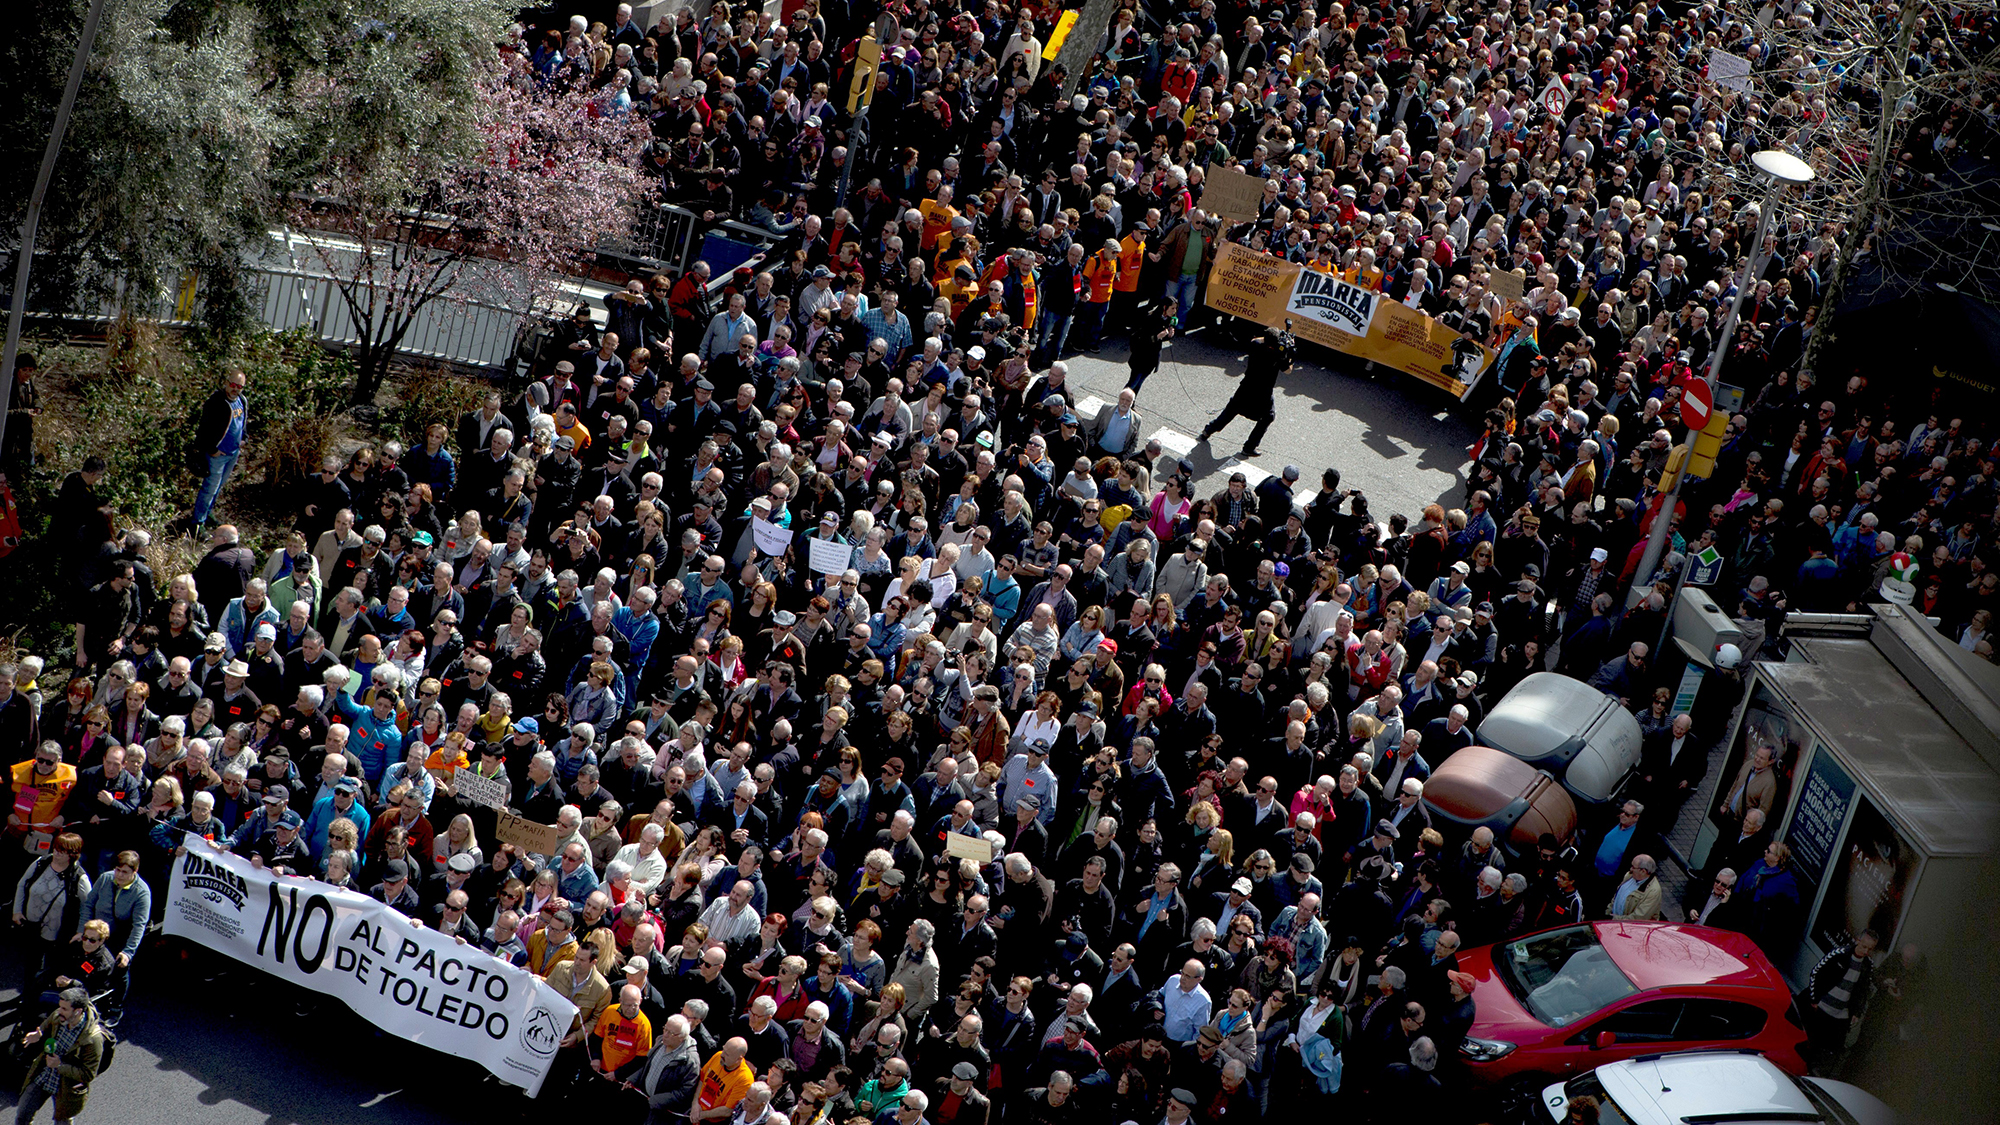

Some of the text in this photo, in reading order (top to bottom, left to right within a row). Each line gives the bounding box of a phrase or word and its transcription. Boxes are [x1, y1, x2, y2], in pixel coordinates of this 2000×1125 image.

[1218, 269, 1278, 293] LUCHANDO POR
[1222, 278, 1231, 286] TU
[1233, 265, 1269, 282] ESTAMOS
[1296, 270, 1372, 320] MAREA
[1215, 300, 1258, 318] NOSOTROS
[1305, 298, 1357, 322] PENSIONISTA
[1387, 329, 1444, 356] VEREMOS UNA TIERRA
[1396, 328, 1424, 341] LEVANTAR
[1432, 342, 1446, 352] VISTA
[1417, 345, 1442, 360] LIBERTAD
[1949, 371, 1996, 394] BOUQUET
[455, 779, 502, 804] CON PENSIONES
[459, 769, 501, 791] LA DERECHA
[1812, 771, 1845, 812] PASSAR FRED A
[459, 787, 492, 806] DE MIERDA
[1809, 779, 1824, 800] CASA
[1825, 796, 1833, 810] NO
[1797, 812, 1805, 824] EL
[1806, 820, 1815, 836] TEU
[498, 829, 544, 850] RAJOY CAPO
[183, 851, 248, 899] MAREA
[190, 880, 240, 903] PENSIONISTA
[174, 901, 244, 934] SALVEMOS LAS PENSIONES
[184, 915, 203, 926] GORDE
[212, 921, 236, 937] PENSIONS
[213, 912, 241, 926] PENSIONS
[257, 882, 334, 974] NO
[350, 920, 509, 1002] AL PACTO
[335, 945, 509, 1040] DE TOLEDO
